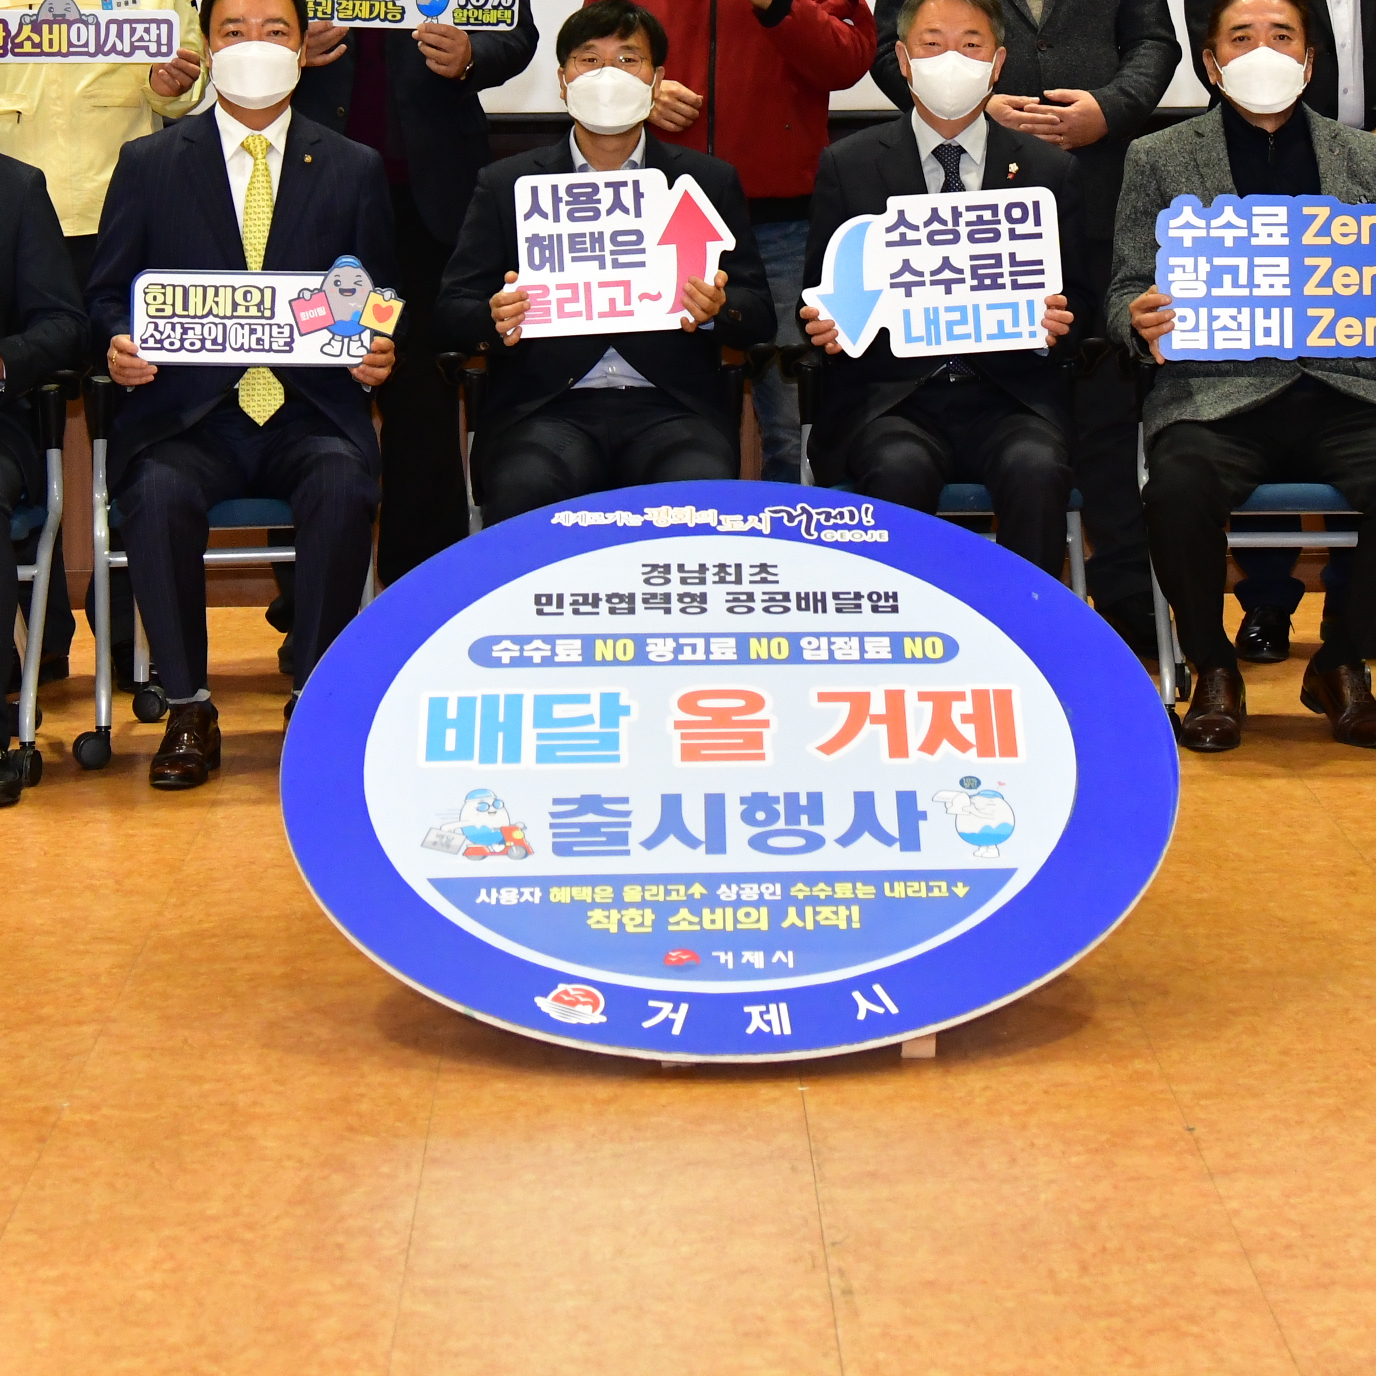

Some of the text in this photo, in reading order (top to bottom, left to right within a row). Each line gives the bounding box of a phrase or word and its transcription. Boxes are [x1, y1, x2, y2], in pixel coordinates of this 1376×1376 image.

[336, 0, 404, 23] 결제가능
[452, 8, 514, 26] 할인혜택
[11, 20, 97, 56] 소비의
[101, 20, 170, 56] 시작!
[523, 179, 644, 223] 사용자
[885, 200, 1043, 248] 소상공인
[1168, 205, 1289, 247] 수수료
[524, 229, 646, 273] 혜택은
[889, 252, 1045, 298] 수수료는
[1168, 256, 1291, 298] 광고료
[143, 283, 276, 320] 힘내세요!
[139, 321, 295, 353] 소상공인 여러분
[903, 299, 1037, 346] 내리고!
[1171, 307, 1293, 350] 입점비
[644, 505, 718, 529] 평화의
[716, 513, 770, 534] 도시
[821, 529, 889, 542] GEOJE
[641, 563, 779, 586] 경남최초
[534, 591, 899, 616] 민관협력형 공공배달앱
[491, 636, 944, 663] 수수료 NO 광고료 NO 입점료 NO
[425, 688, 1020, 764] 배달 올 거제
[548, 790, 928, 857] 출시행사
[476, 880, 949, 905] 사용자 혜택은 올리고 상공인 수수료는 내리고
[586, 905, 861, 933] 착한 소비의 시작!
